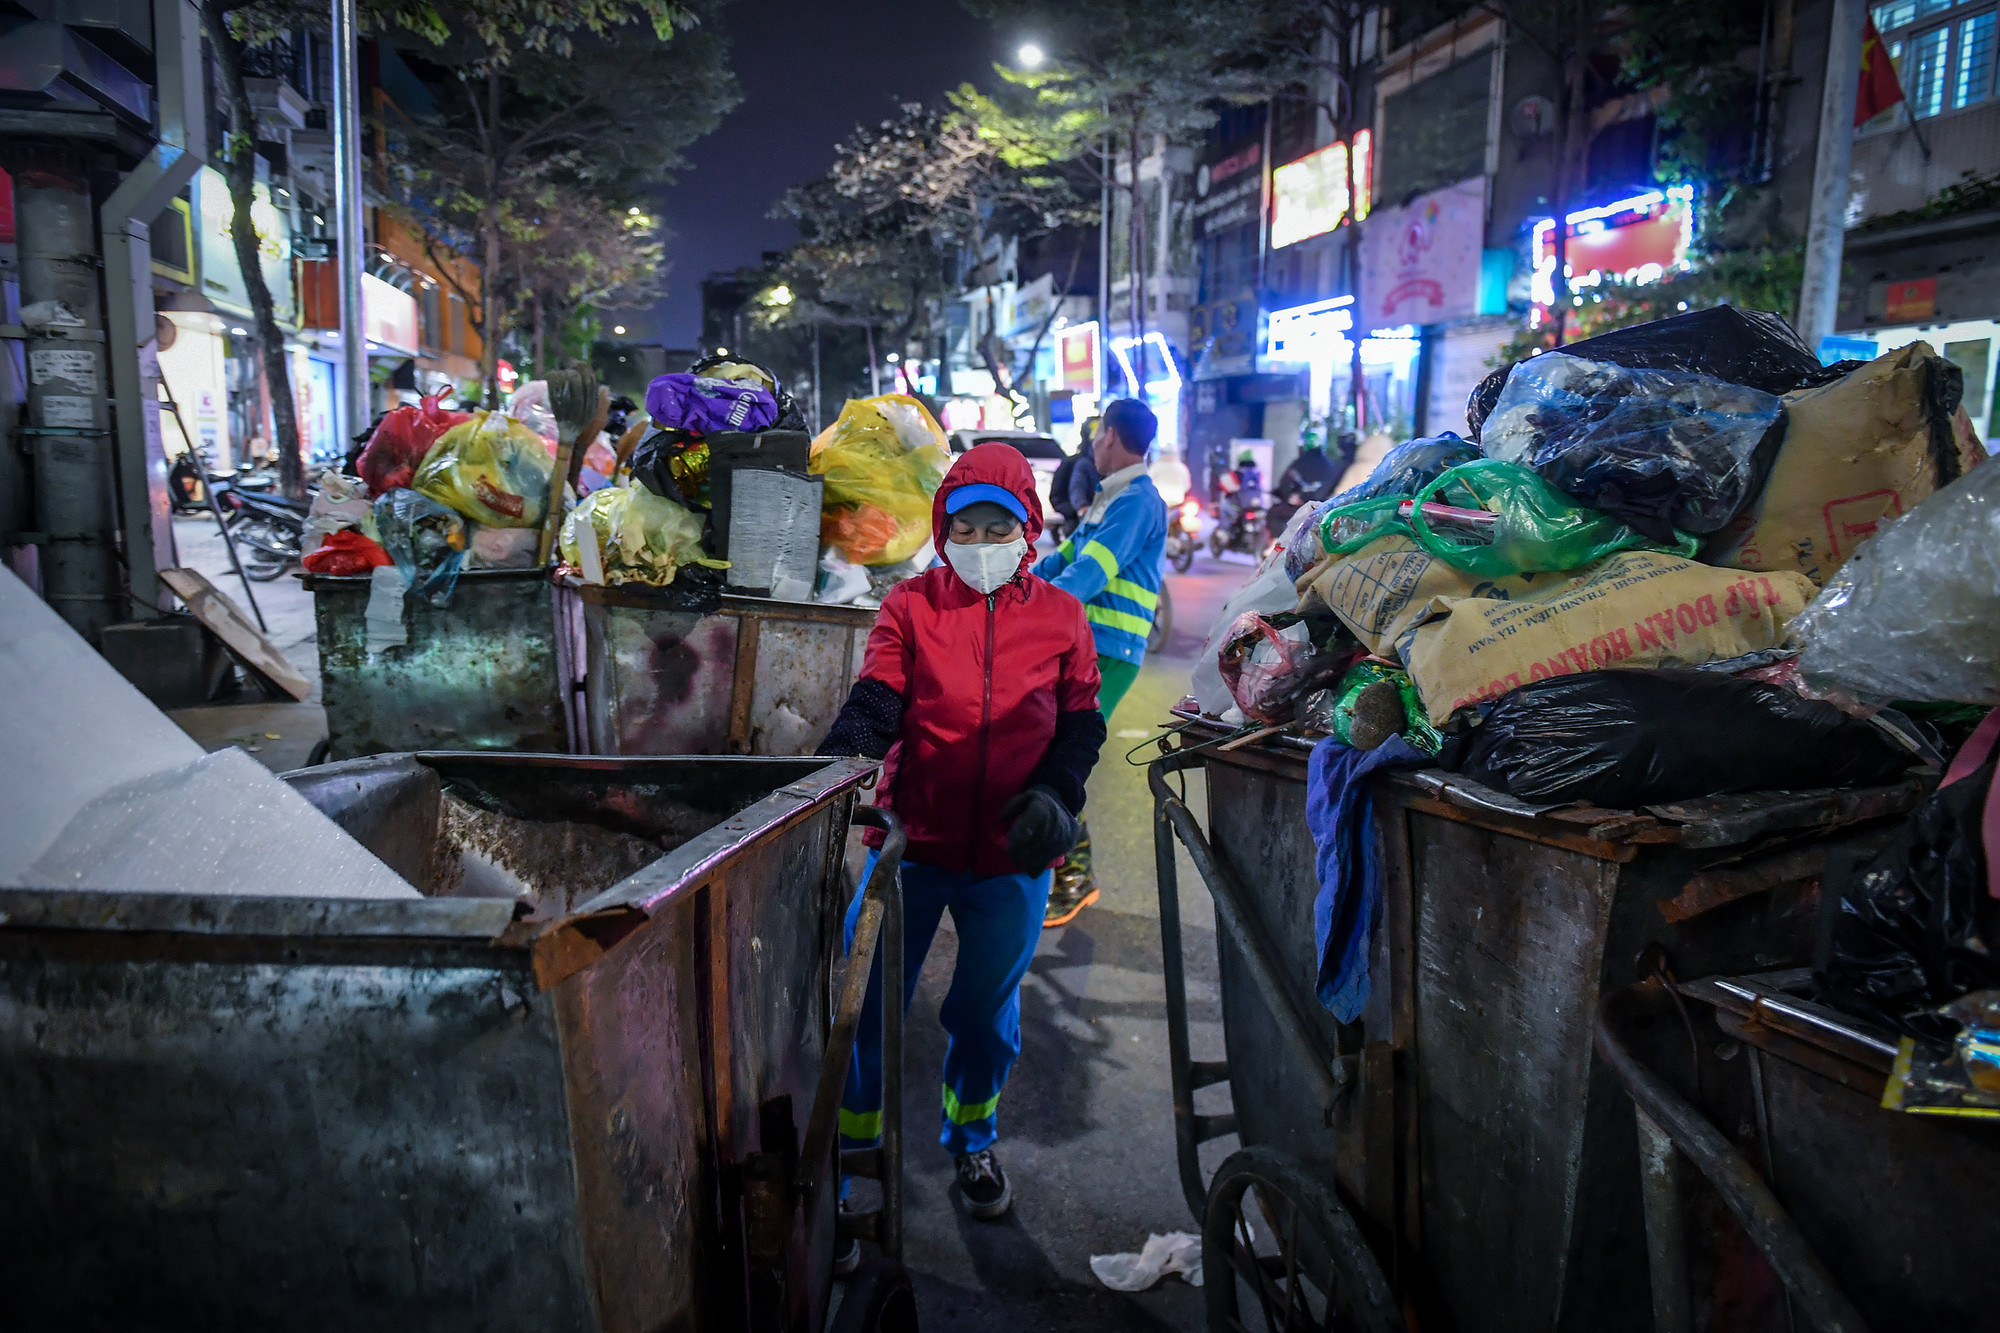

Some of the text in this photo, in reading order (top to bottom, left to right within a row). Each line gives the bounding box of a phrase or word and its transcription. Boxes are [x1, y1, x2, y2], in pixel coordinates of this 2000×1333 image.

[1647, 562, 1692, 578] THANH
[1560, 590, 1606, 612] THANH
[1724, 575, 1782, 620] TẬP
[1634, 593, 1718, 650] ĐOÀN
[1468, 636, 1497, 654] NAM
